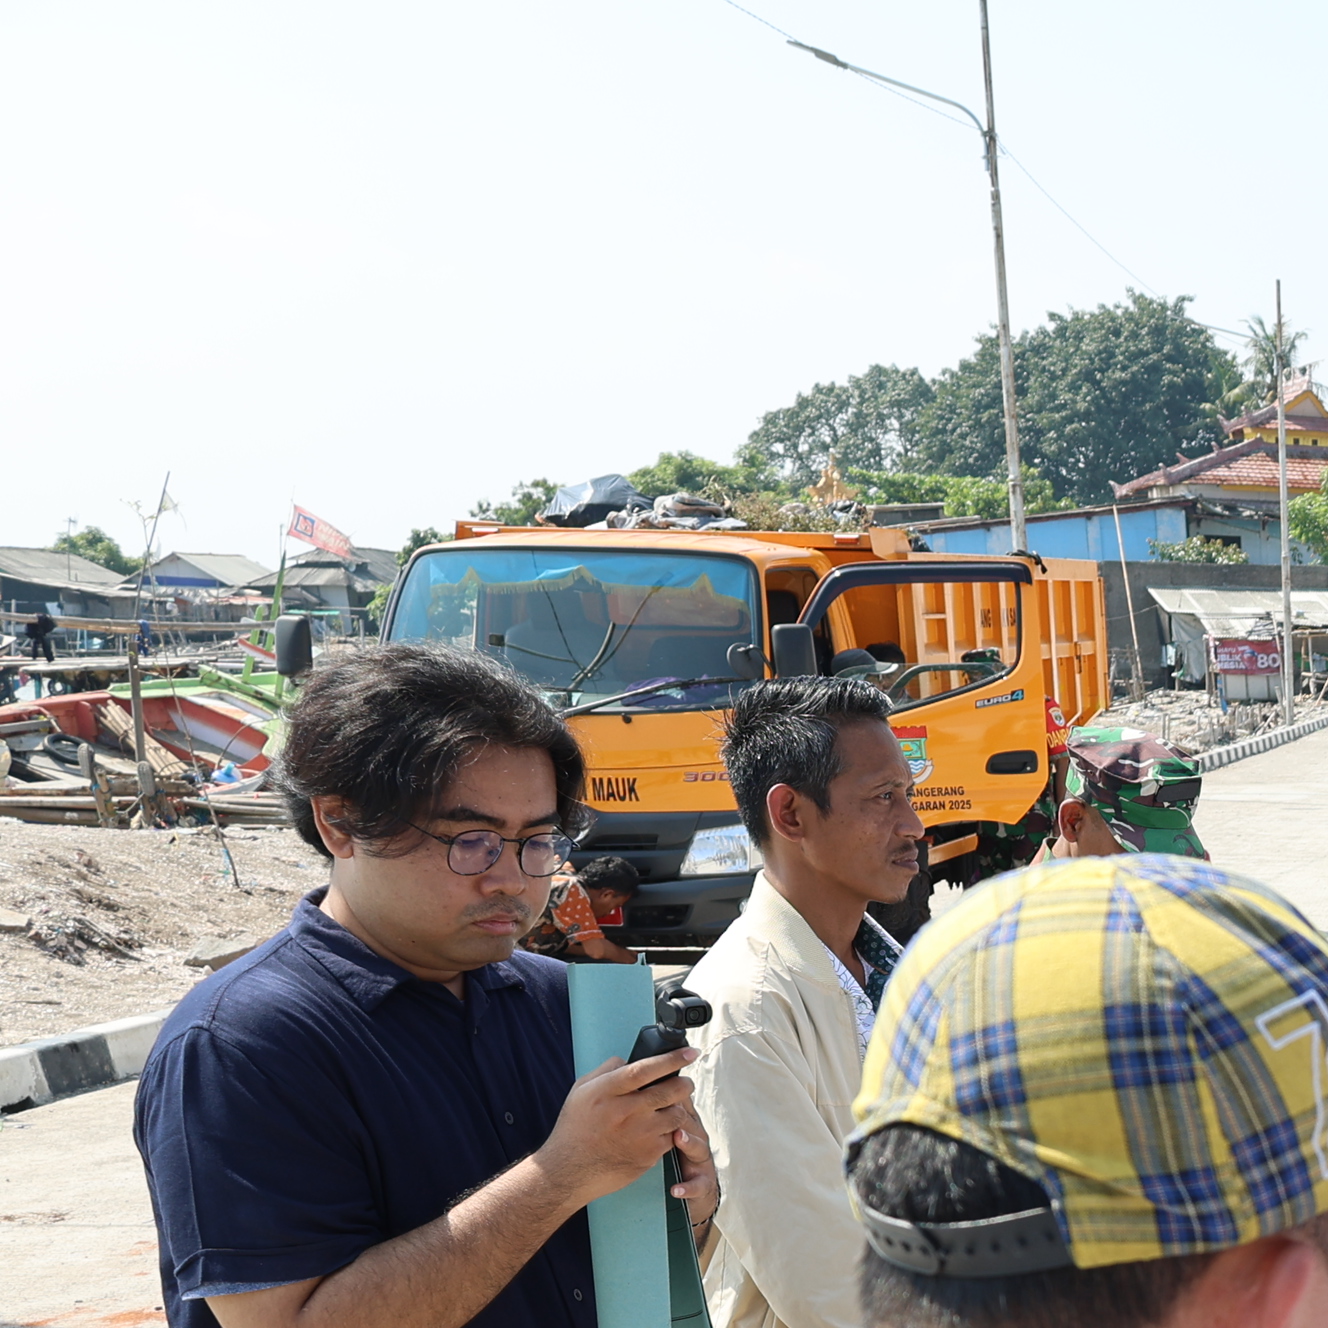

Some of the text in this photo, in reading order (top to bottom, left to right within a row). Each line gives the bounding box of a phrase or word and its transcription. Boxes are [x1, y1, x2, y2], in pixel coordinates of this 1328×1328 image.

[1257, 653, 1280, 669] 80
[592, 777, 640, 802] MAUK
[948, 799, 972, 811] 2025
